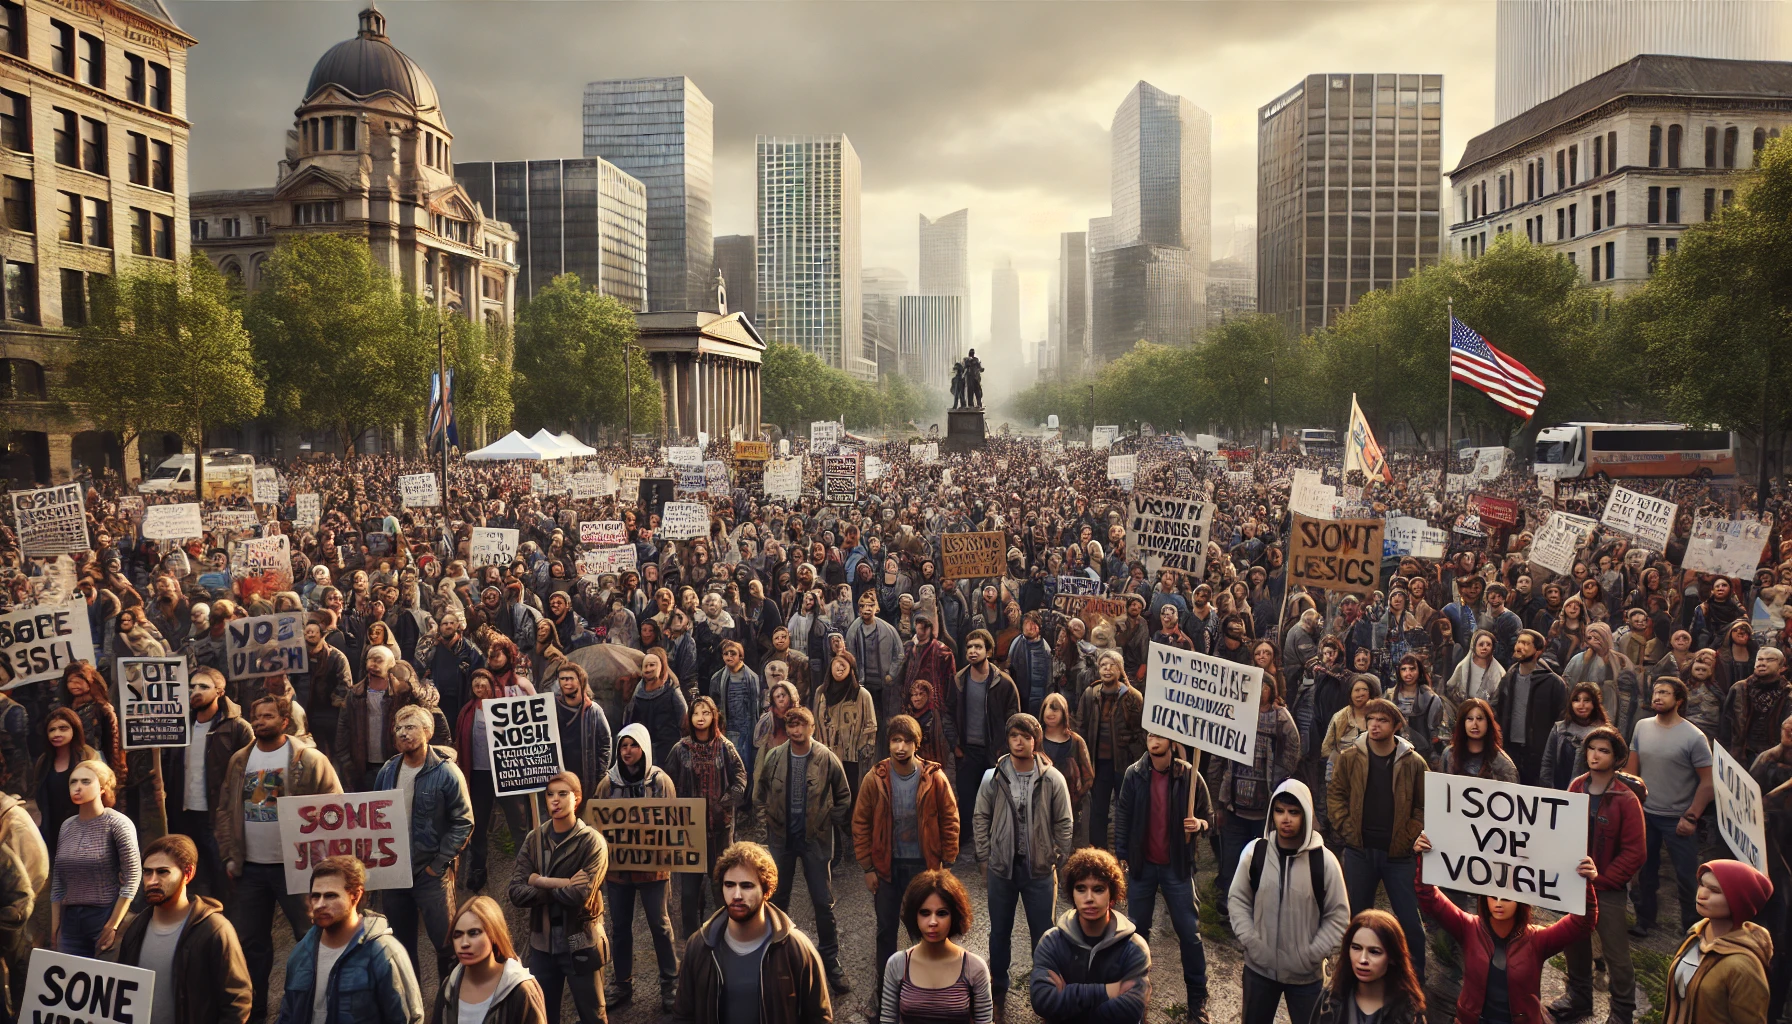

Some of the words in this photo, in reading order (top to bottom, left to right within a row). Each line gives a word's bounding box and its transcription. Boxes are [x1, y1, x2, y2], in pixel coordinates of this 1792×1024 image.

[298, 800, 394, 834] SONE
[1461, 787, 1570, 830] SONT
[38, 965, 139, 1024] SONE
